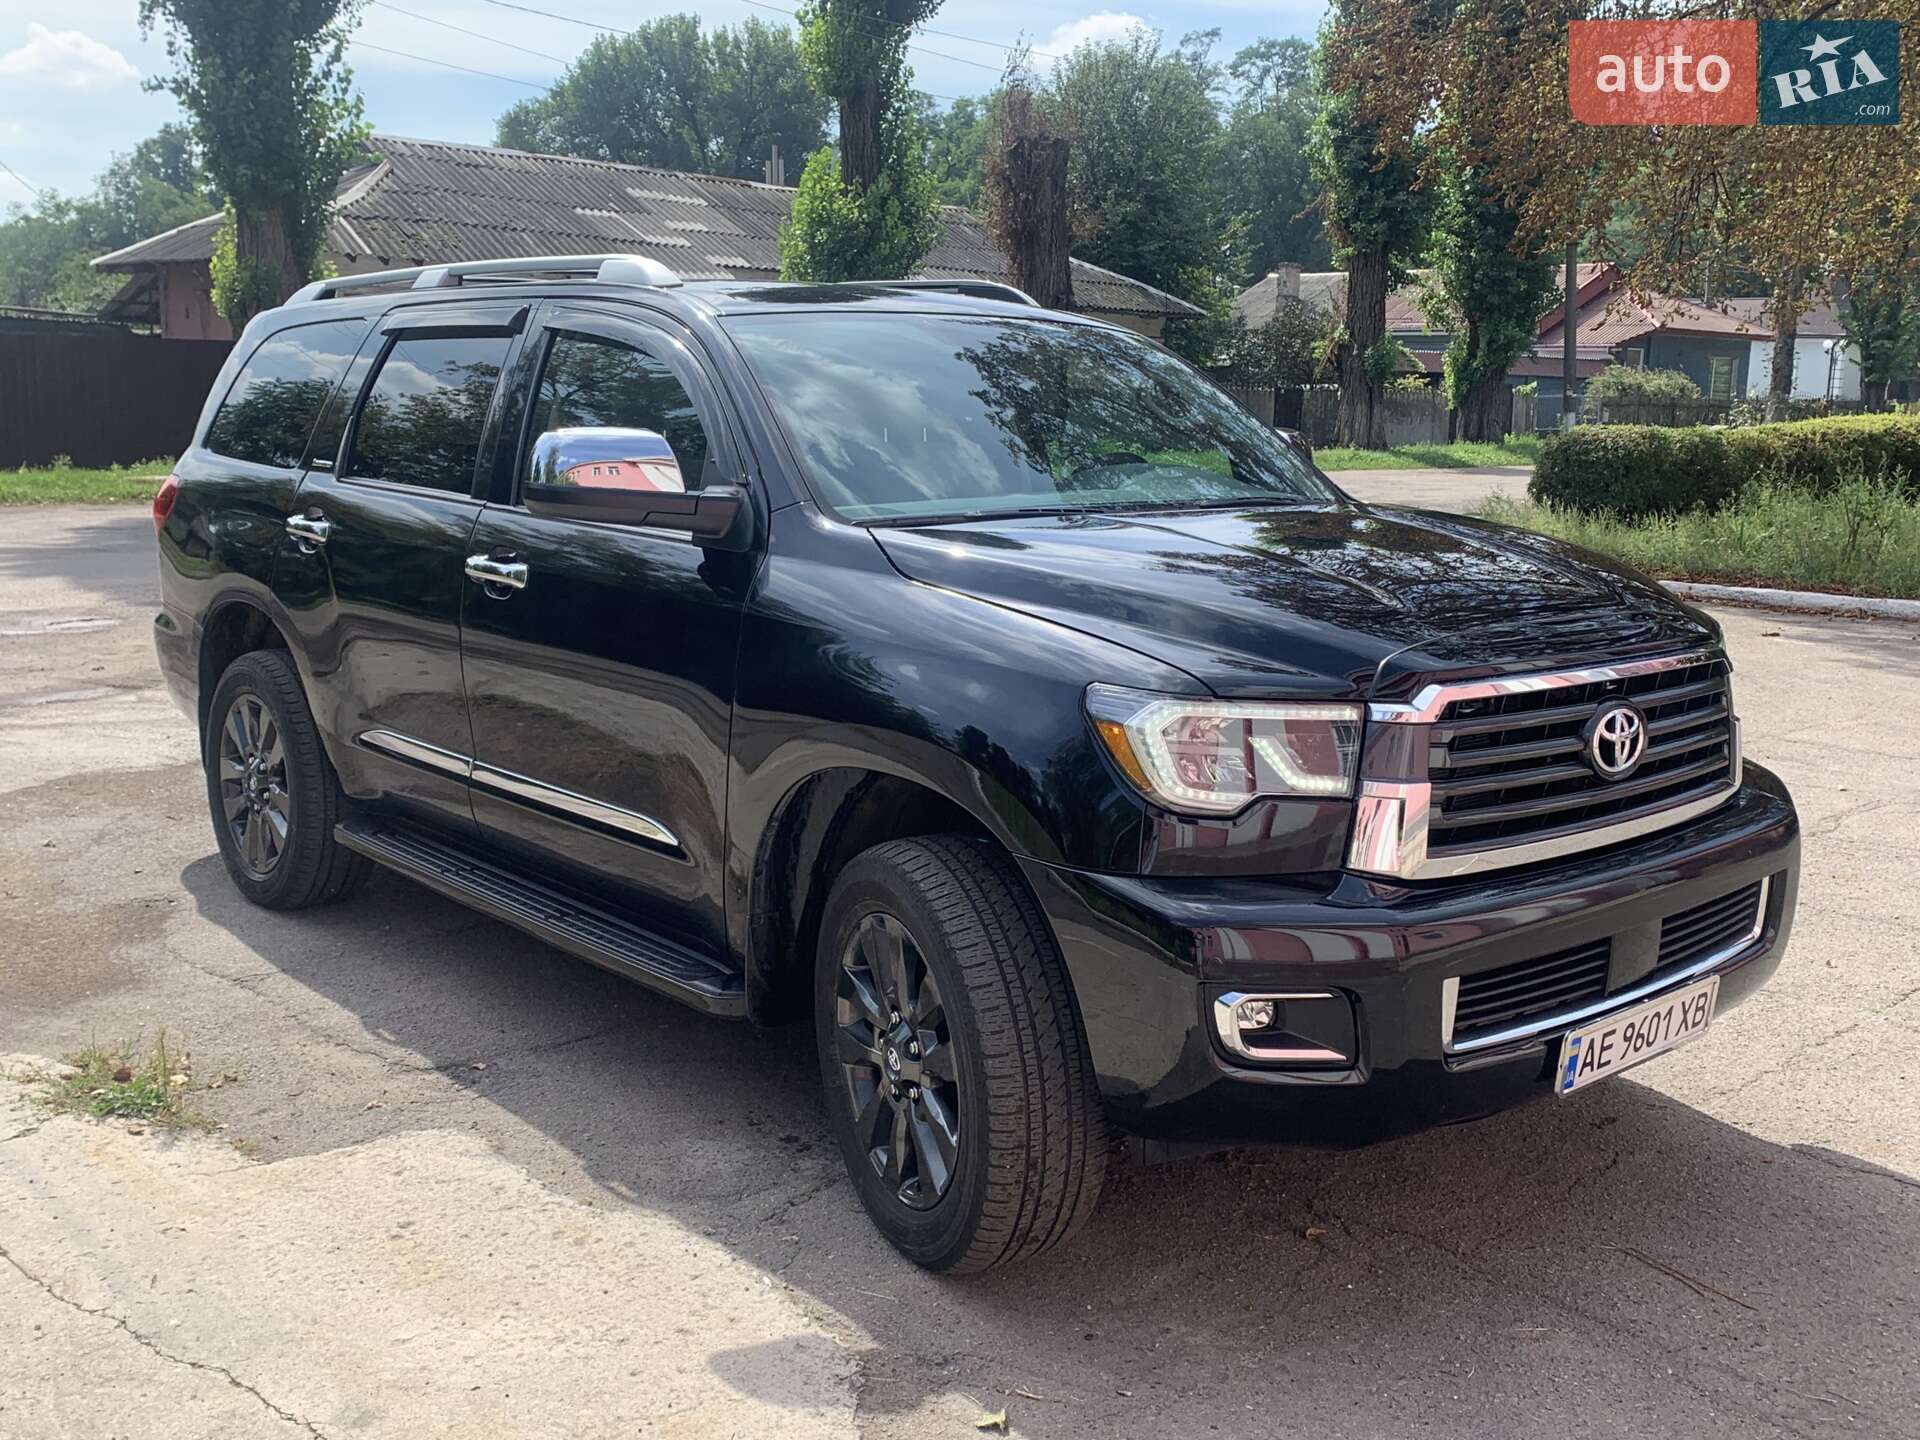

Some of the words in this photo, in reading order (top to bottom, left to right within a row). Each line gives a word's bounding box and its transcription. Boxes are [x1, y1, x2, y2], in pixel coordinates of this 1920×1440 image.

[1578, 1028, 1617, 1078] AE
[1620, 1005, 1675, 1061] 9601
[1674, 991, 1709, 1038] XB
